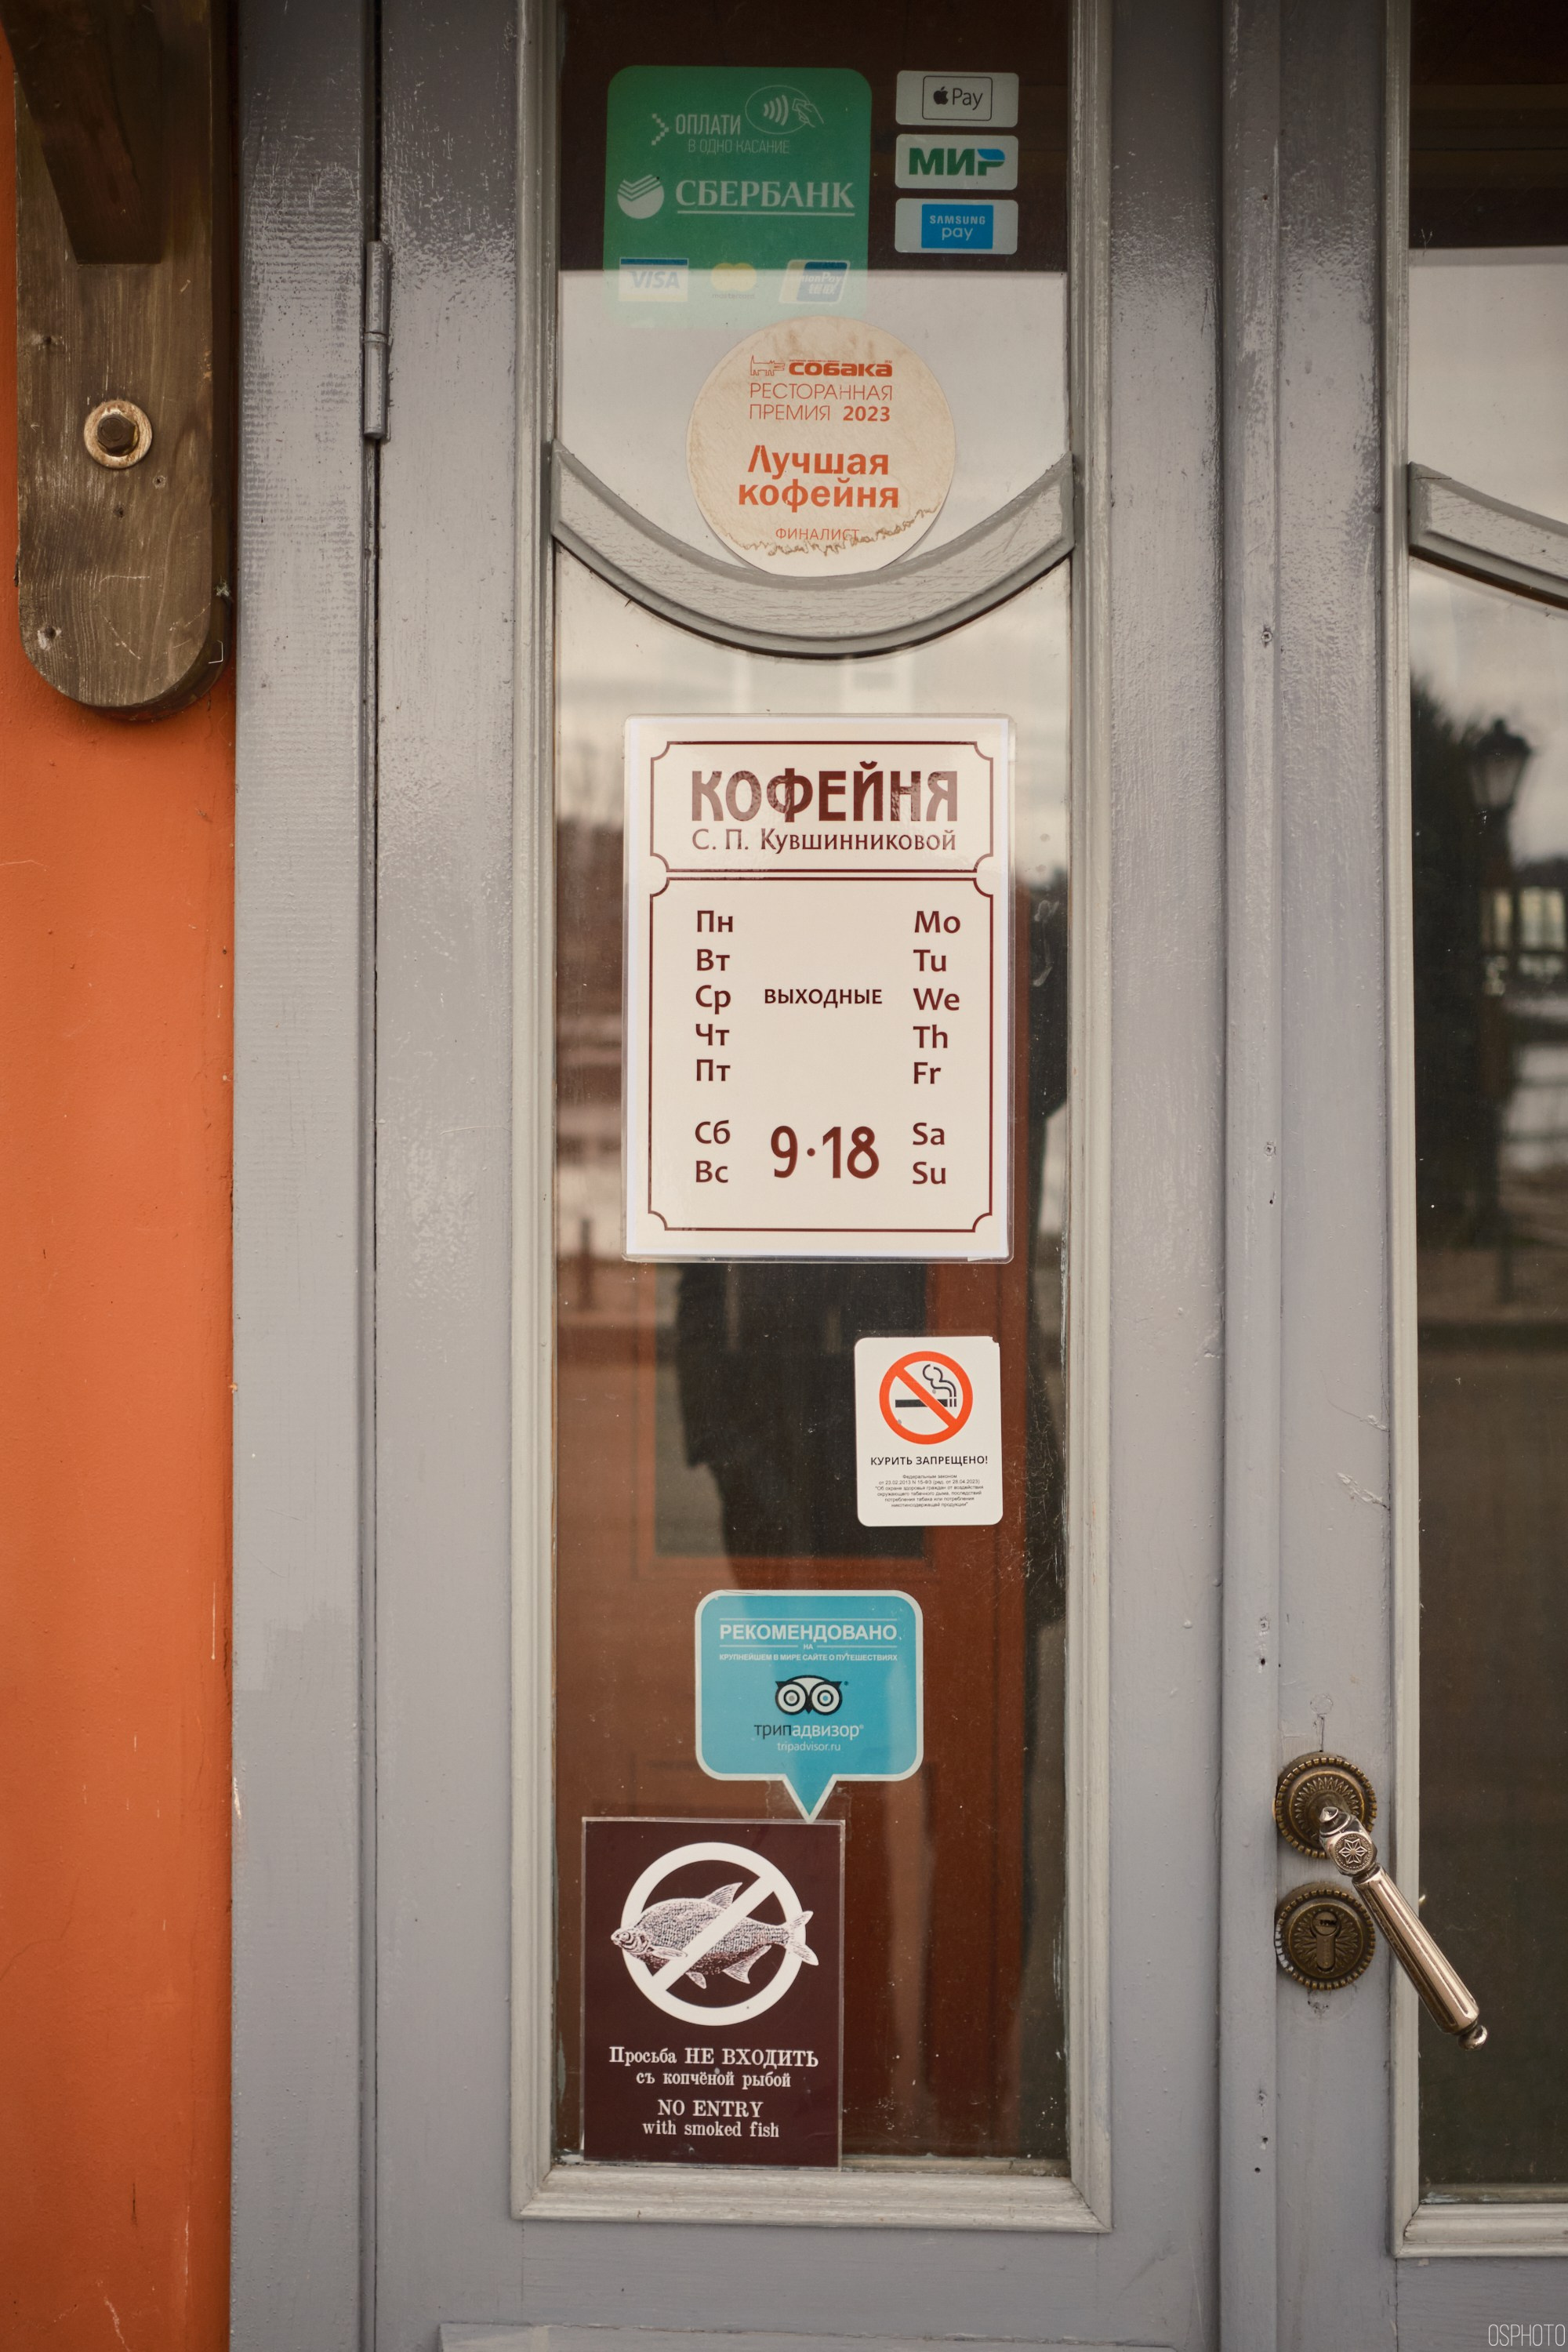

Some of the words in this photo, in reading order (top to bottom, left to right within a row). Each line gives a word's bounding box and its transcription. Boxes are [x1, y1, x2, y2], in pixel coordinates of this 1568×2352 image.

[952, 86, 984, 110] Pay
[675, 114, 742, 136] ОПЛАТИ
[688, 139, 696, 154] В
[699, 139, 734, 155] ОДНО
[737, 139, 790, 154] КАСАНИЕ
[909, 147, 1006, 176] МИР
[675, 180, 855, 209] СБЕРБАНК
[929, 215, 986, 225] SAMSUNG
[942, 226, 973, 241] pay
[629, 270, 681, 289] VISA
[798, 271, 843, 286] nionPay
[789, 361, 893, 377] собака
[750, 383, 893, 401] РЕСТОРАННАЯ
[750, 404, 830, 421] ПРЕМИЯ
[843, 405, 891, 422] 2023
[747, 445, 889, 480] Лучшая
[739, 477, 898, 513] кофейня
[775, 528, 860, 541] ФИНАЛИСТ
[691, 760, 958, 823] КОФЕЙНЯ
[692, 828, 717, 851] С.
[725, 828, 750, 851] П.
[761, 828, 956, 855] Кувшинниковой
[696, 910, 734, 933] Пн
[914, 910, 961, 934] Mo
[696, 949, 730, 971] Вт
[913, 949, 947, 972] Tu
[695, 985, 731, 1014] Ср
[764, 989, 883, 1009] ВЫХОДНЫЕ
[913, 988, 960, 1011] We
[695, 1024, 730, 1046] Чт
[913, 1025, 949, 1049] Th
[696, 1059, 731, 1082] Пт
[913, 1062, 942, 1084] Fr
[695, 1120, 731, 1145] Сб
[912, 1122, 946, 1145] Sa
[695, 1160, 729, 1183] Вс
[913, 1161, 946, 1185] Su
[870, 1457, 913, 1465] КУРИТЬ
[916, 1455, 988, 1467] ЗАПРЕЩЕНО!
[720, 1624, 897, 1642] РЕКОМЕНДОВАНО
[754, 1724, 860, 1739] трипадвизор
[777, 1741, 841, 1751] tripadvisor.ru
[609, 2046, 677, 2067] Просьба
[684, 2047, 714, 2064] НЕ
[721, 2048, 818, 2069] ВХОДИТЬ
[636, 2071, 655, 2084] съ
[663, 2071, 735, 2086] копчёной
[742, 2072, 791, 2090] рыбой
[657, 2100, 685, 2116] NO
[693, 2100, 764, 2118] ENTRY
[643, 2120, 677, 2135] with
[684, 2121, 742, 2137] smoked
[750, 2122, 779, 2137] fish
